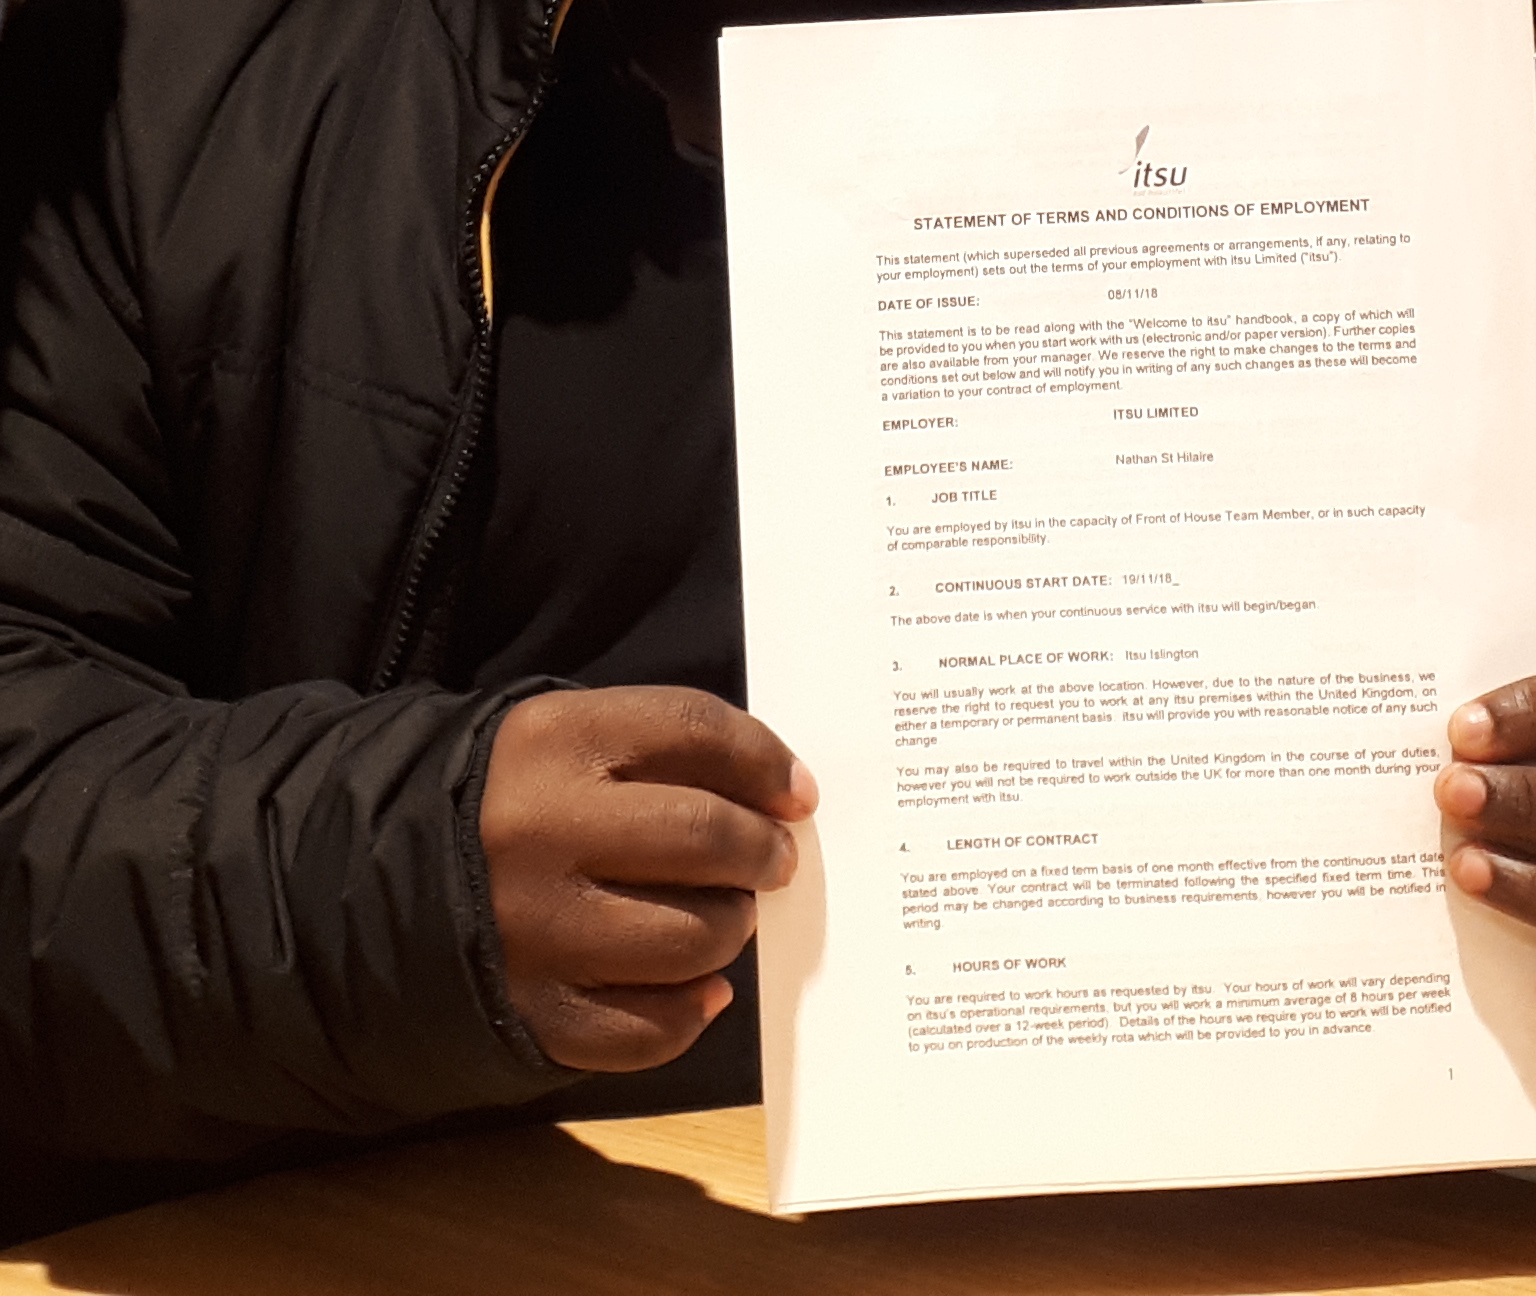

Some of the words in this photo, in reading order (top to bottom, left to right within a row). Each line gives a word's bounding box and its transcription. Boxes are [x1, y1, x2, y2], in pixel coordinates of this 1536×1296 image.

[1133, 160, 1188, 188] itsu
[913, 214, 1007, 230] STATEMENT
[1010, 213, 1032, 225] OF
[1035, 210, 1090, 224] TERMS
[1095, 209, 1128, 221] AND
[1132, 204, 1230, 220] CONDITIONS
[1233, 203, 1256, 216] OF
[1260, 199, 1370, 215] EMPLOYMENT
[875, 255, 901, 266] This
[903, 253, 960, 264] statement
[962, 250, 1000, 263] (which
[1003, 247, 1070, 261] superseded
[1073, 246, 1087, 256] all
[1089, 245, 1139, 258] previous
[1141, 242, 1210, 256] agreements
[1213, 243, 1225, 251] or
[1315, 236, 1324, 246] if
[1353, 234, 1397, 246] relating
[1399, 234, 1411, 243] to
[876, 272, 902, 283] your
[904, 266, 979, 281] employment)
[982, 265, 1006, 276] sets
[1008, 264, 1028, 274] out
[1029, 263, 1049, 273] the
[1051, 263, 1084, 272] terms
[1087, 260, 1099, 271] of
[1101, 261, 1128, 273] your
[1130, 257, 1201, 270] employment
[1203, 256, 1228, 266] with
[1230, 255, 1252, 265] itsu
[1254, 252, 1297, 264] Limited
[877, 299, 913, 311] DATE
[915, 298, 934, 309] OF
[1107, 288, 1158, 300] 08/11/18
[1113, 408, 1143, 420] ITSU
[1146, 407, 1199, 418] LIMITED
[884, 461, 968, 476] EMPLOYEE'S
[1115, 454, 1158, 464] Nathan
[1160, 453, 1174, 463] St
[1176, 452, 1214, 462] Hilaire
[931, 492, 958, 503] JOB
[961, 490, 998, 502] TITLE
[886, 526, 910, 536] You
[912, 526, 932, 535] are
[934, 520, 991, 535] employed
[994, 521, 1008, 532] by
[1011, 520, 1032, 529] itsu
[1034, 518, 1046, 528] in
[1048, 517, 1067, 528] the
[1069, 515, 1118, 528] capacity
[1120, 514, 1133, 525] of
[1135, 514, 1166, 524] Front
[1169, 513, 1181, 523] of
[1183, 513, 1222, 522] House
[1225, 510, 1259, 521] Team
[1317, 510, 1330, 518] or
[1332, 508, 1344, 518] in
[1346, 506, 1375, 517] such
[1377, 505, 1426, 518] capacity
[934, 579, 1023, 593] CONTINUOUS
[1025, 577, 1069, 588] START
[890, 616, 913, 626] The
[915, 615, 952, 625] above
[954, 612, 980, 622] date
[983, 610, 993, 621] is
[995, 610, 1028, 620] when
[1030, 610, 1057, 621] your
[1059, 607, 1123, 618] continuous
[1125, 604, 1168, 615] service
[1170, 603, 1195, 613] with
[1197, 603, 1219, 613] itsu
[1221, 601, 1241, 612] will
[938, 656, 996, 668] NORMAL
[999, 653, 1043, 665] PLACE
[1046, 652, 1064, 663] OF
[1125, 650, 1147, 660] Itsu
[1149, 649, 1199, 662] Islington
[946, 838, 1001, 850] LENGTH
[1004, 836, 1023, 847] OF
[1025, 833, 1099, 846] CONTRACT
[900, 873, 925, 883] You
[927, 873, 947, 882] are
[950, 868, 1008, 882] employed
[1011, 869, 1027, 877] on
[1030, 868, 1038, 877] a
[1040, 865, 1069, 876] fixed
[1071, 866, 1099, 875] term
[1101, 864, 1133, 874] basis
[1136, 862, 1149, 873] of
[1151, 864, 1174, 873] one
[1177, 861, 1215, 872] month
[1217, 859, 1267, 871] effective
[1270, 858, 1298, 869] from
[1300, 857, 1320, 868] the
[1322, 857, 1387, 867] continuous
[1390, 853, 1417, 864] start
[1419, 853, 1445, 863] date
[952, 960, 1000, 973] HOURS
[1002, 959, 1022, 970] OF
[1024, 957, 1067, 969] WORK
[906, 995, 930, 1005] You
[933, 995, 953, 1004] are
[956, 991, 1006, 1004] required
[1009, 991, 1021, 1000] to
[1024, 989, 1053, 1000] work
[1056, 989, 1089, 998] hours
[1092, 989, 1107, 997] as
[1110, 985, 1170, 998] requested
[1172, 985, 1188, 997] by
[1223, 983, 1252, 993] Your
[1254, 982, 1289, 992] hours
[1291, 979, 1304, 990] of
[1307, 979, 1335, 989] work
[1338, 977, 1358, 987] will
[1361, 978, 1386, 989] vary
[1389, 973, 1451, 986] depending
